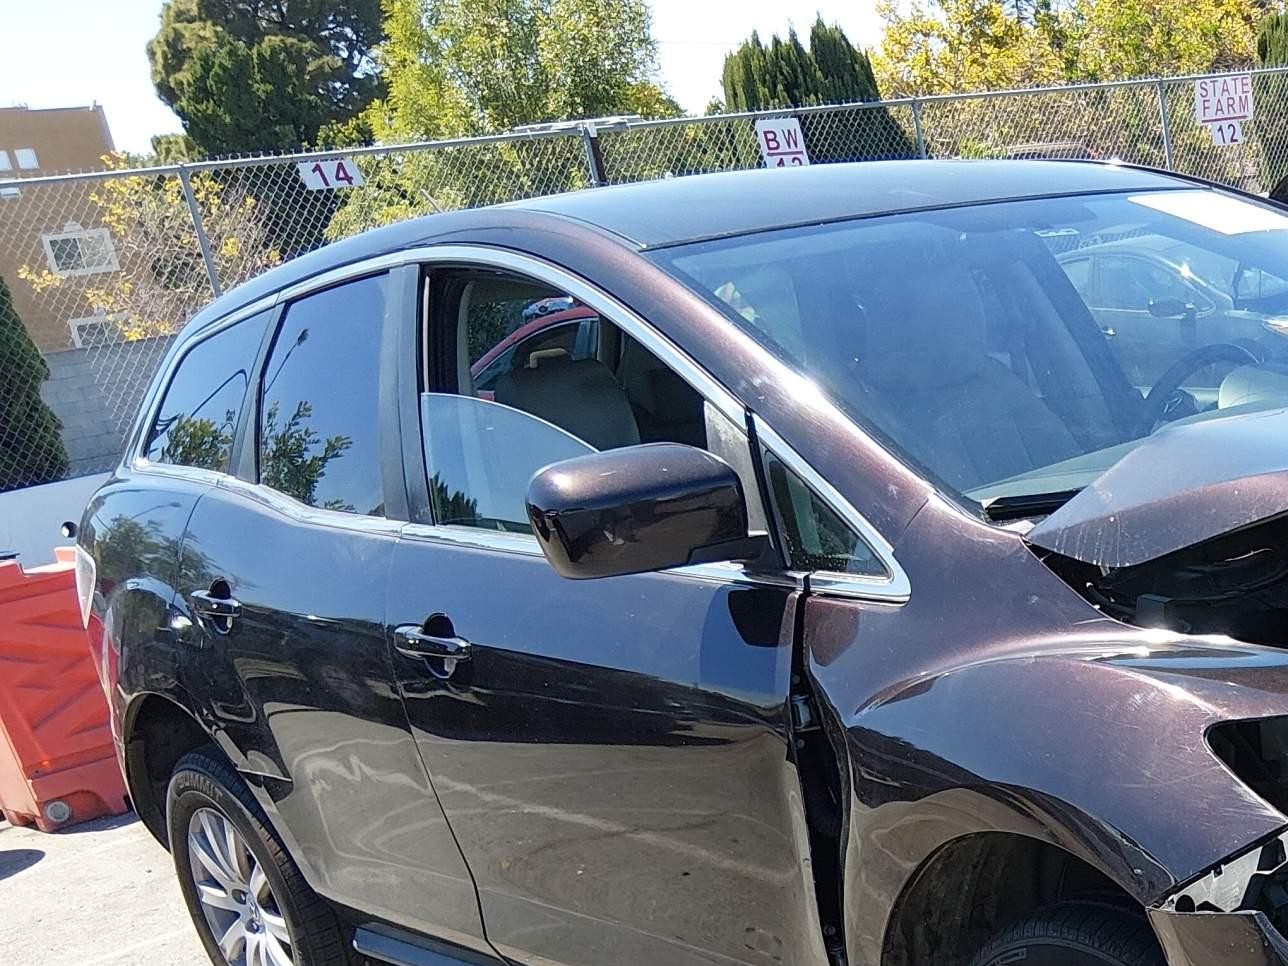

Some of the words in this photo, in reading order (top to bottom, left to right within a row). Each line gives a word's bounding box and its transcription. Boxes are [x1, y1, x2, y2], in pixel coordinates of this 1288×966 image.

[1199, 76, 1250, 98] STATE
[1202, 95, 1249, 117] FARM
[1217, 123, 1239, 144] 12
[311, 161, 354, 187] 14
[177, 771, 223, 802] SUMMIT
